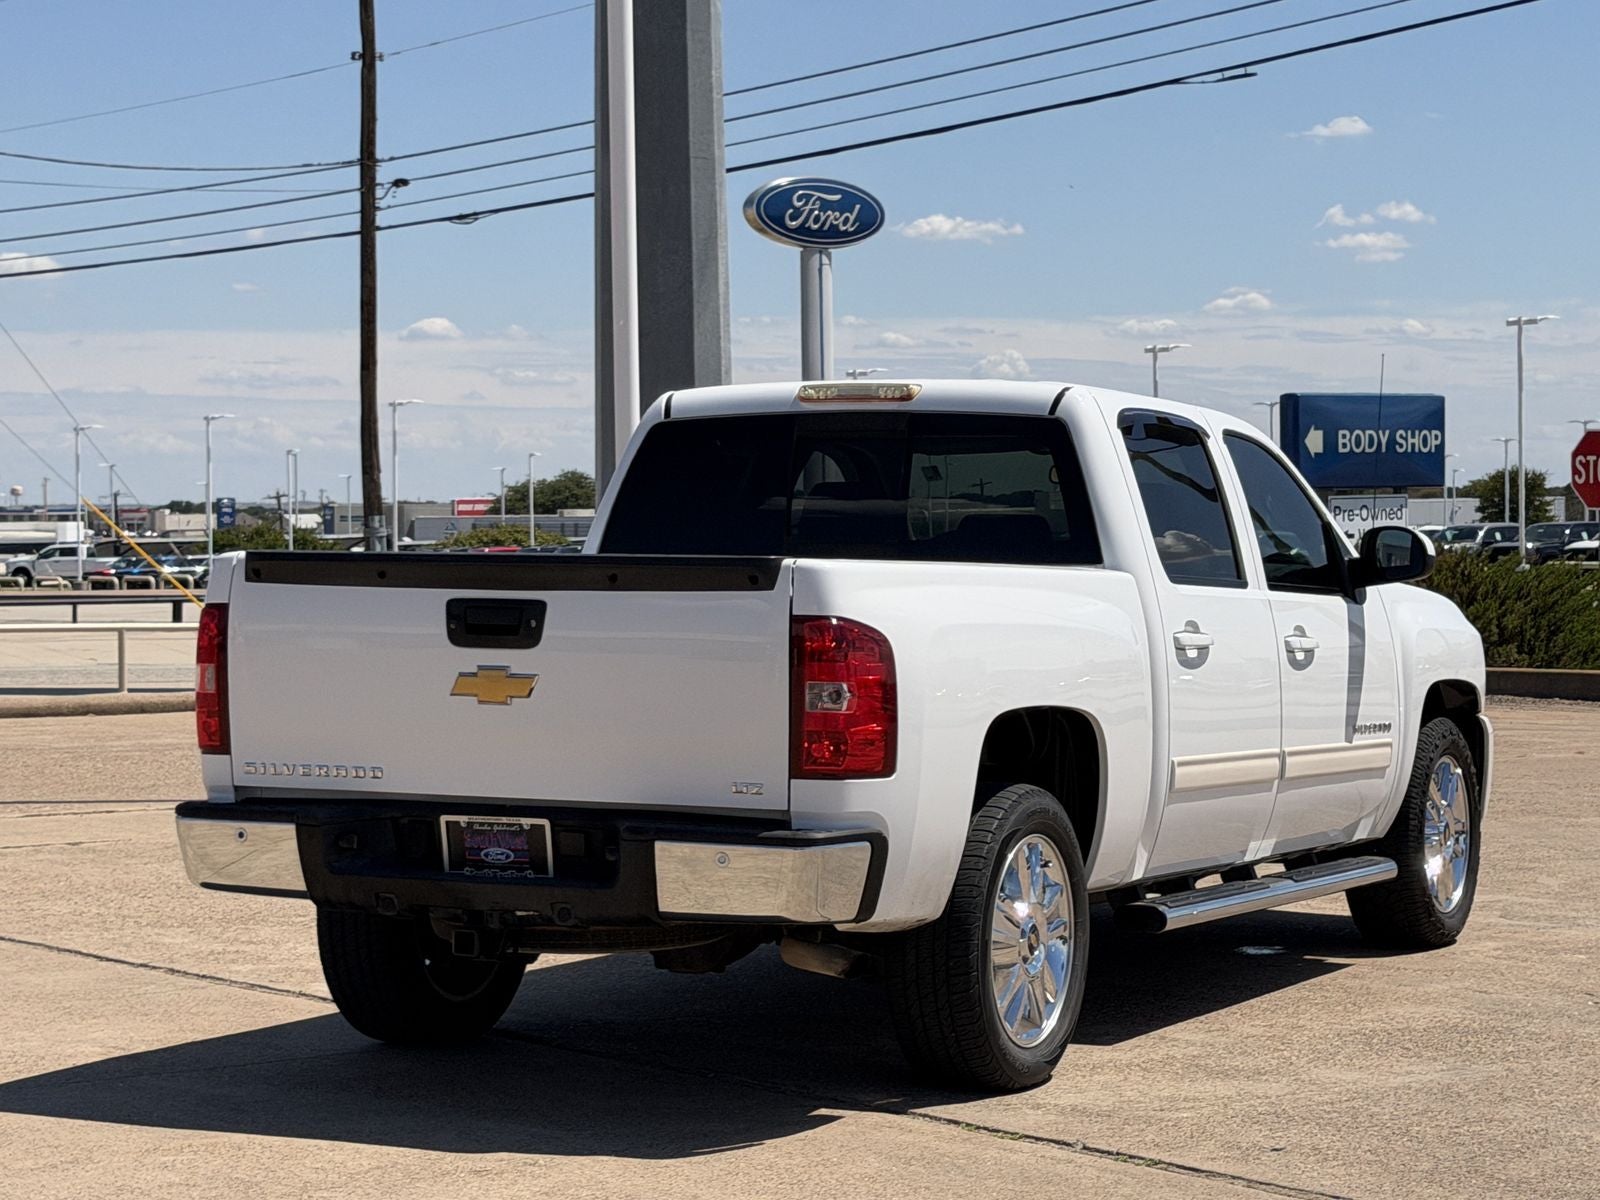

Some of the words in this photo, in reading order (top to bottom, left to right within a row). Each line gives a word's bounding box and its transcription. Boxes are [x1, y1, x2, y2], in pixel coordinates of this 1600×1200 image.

[785, 190, 861, 232] Ford
[1337, 429, 1390, 454] BODY
[1395, 429, 1442, 454] SHOP
[1333, 504, 1404, 522] Pre-Owned
[243, 761, 384, 779] SILVERADO
[731, 782, 764, 796] LTZ
